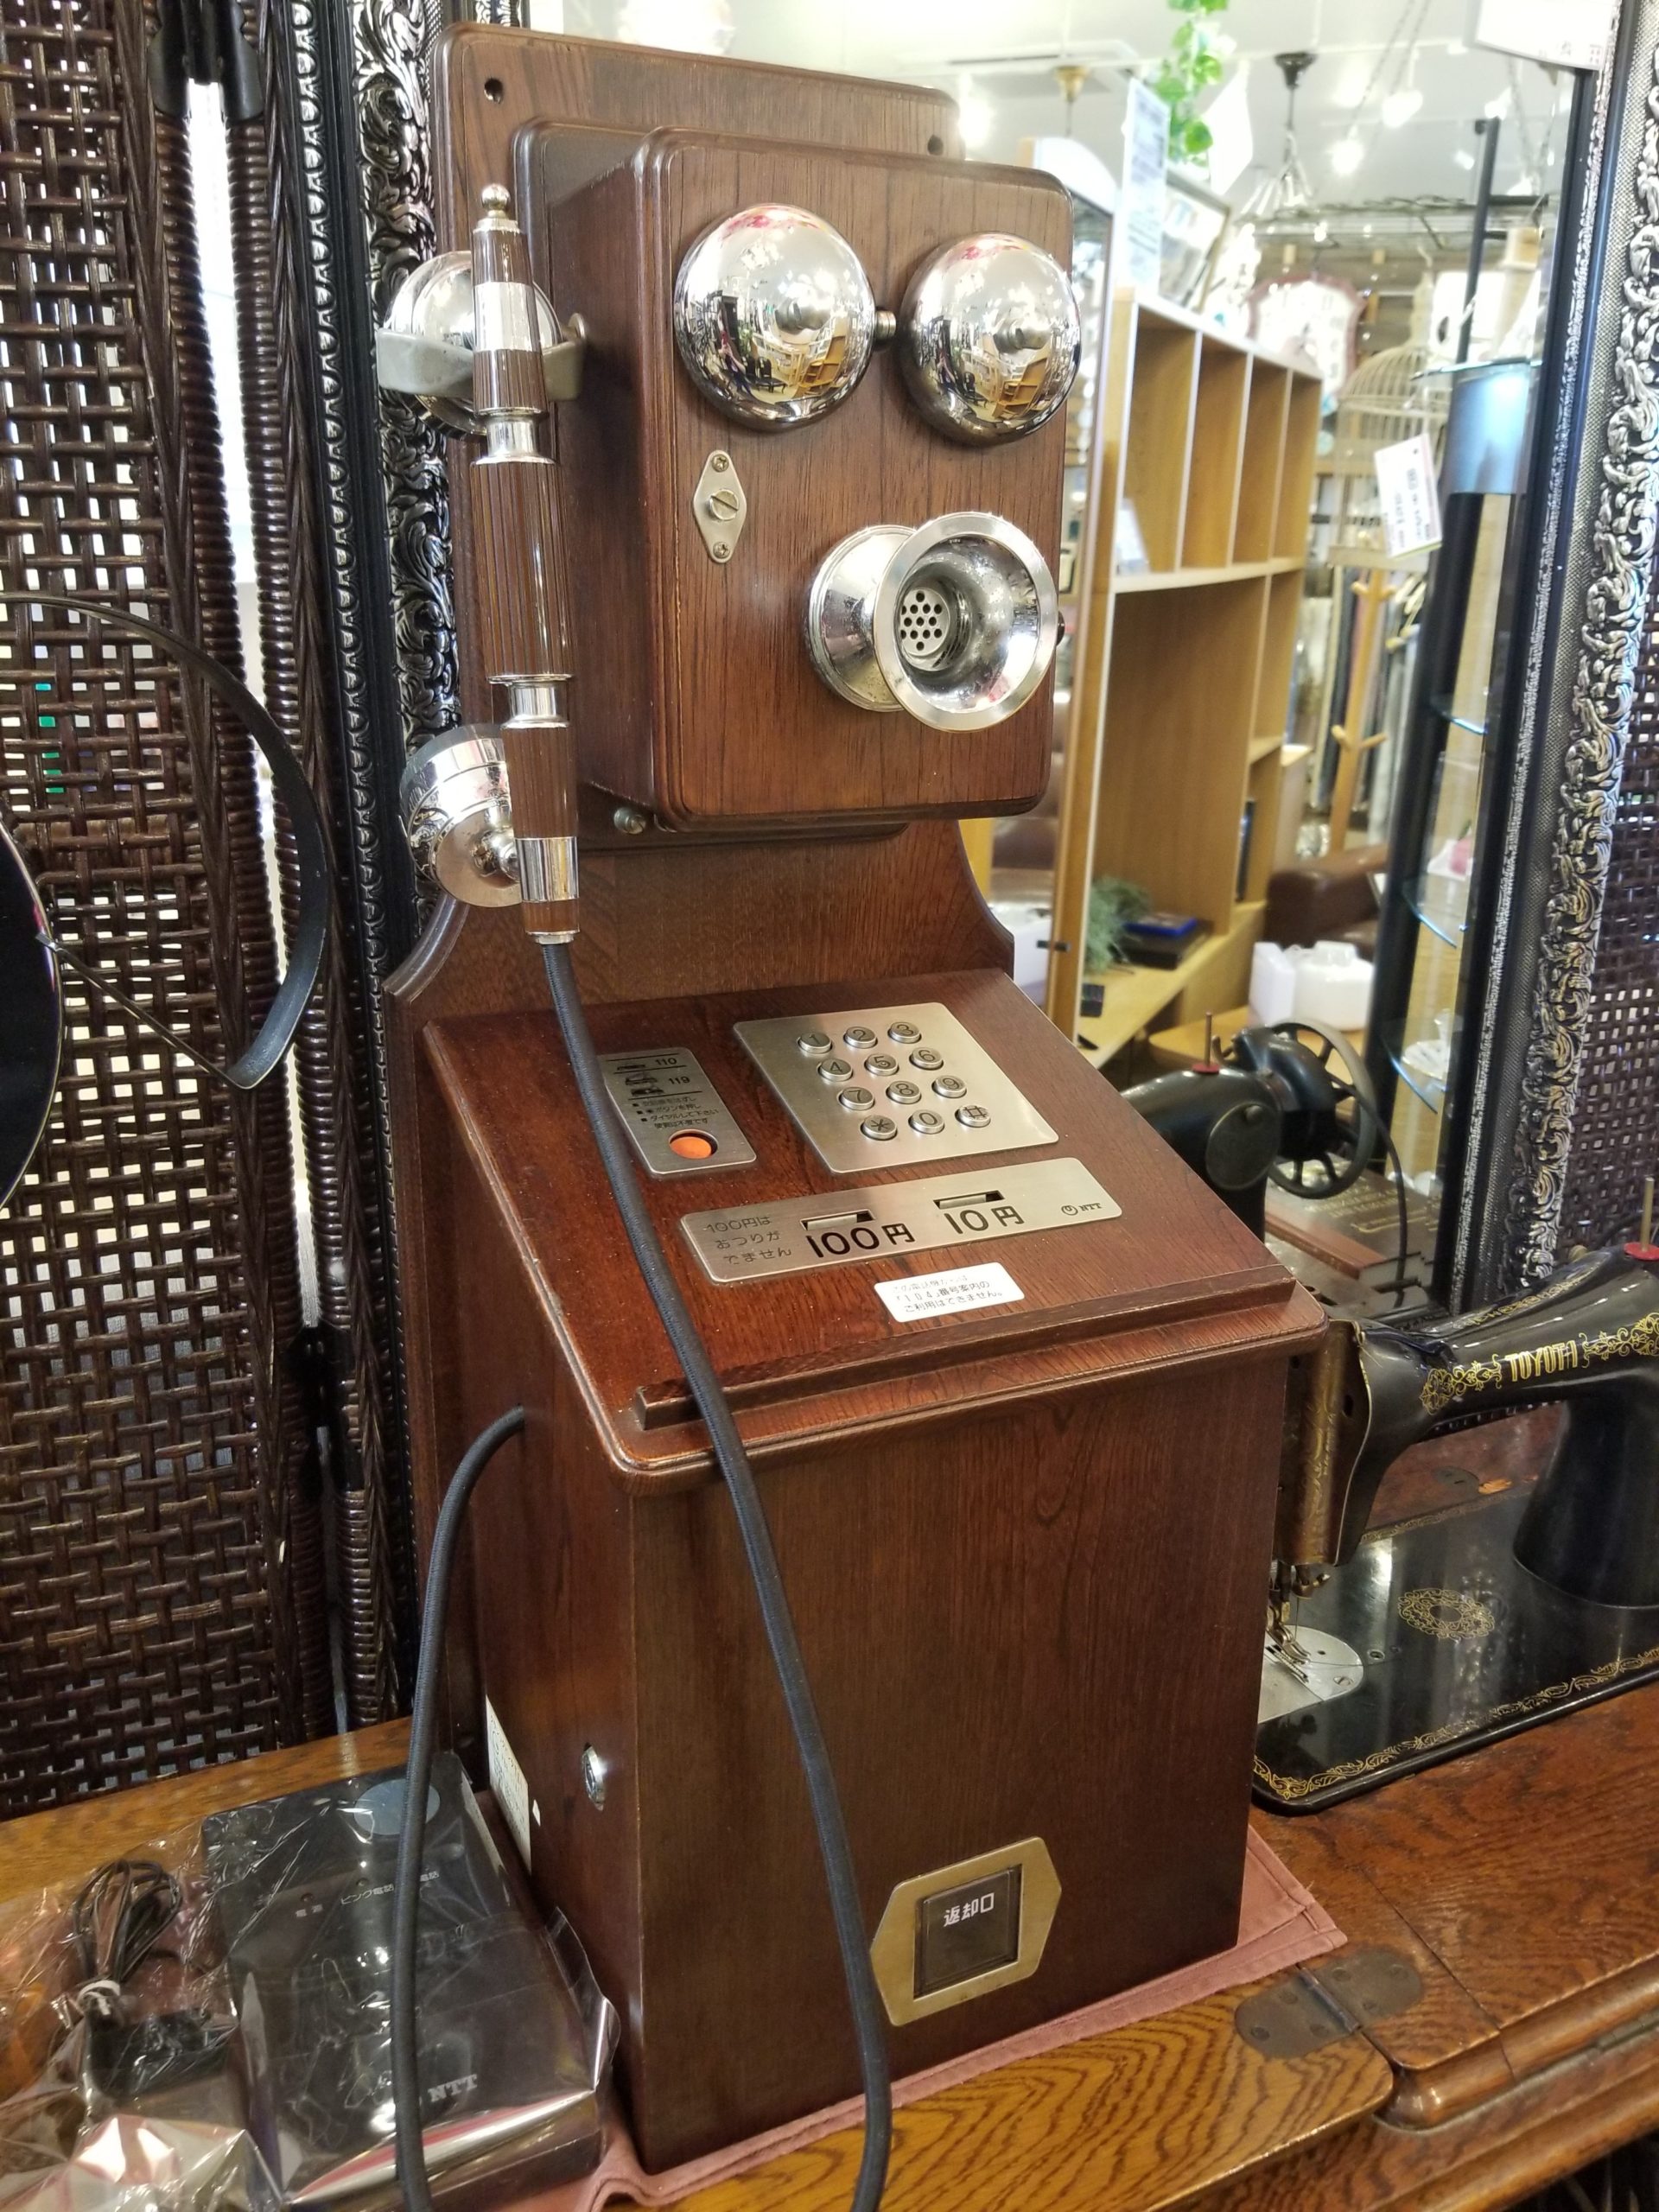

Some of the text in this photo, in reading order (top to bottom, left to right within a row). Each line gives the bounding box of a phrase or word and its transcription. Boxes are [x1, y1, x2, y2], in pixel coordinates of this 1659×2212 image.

[852, 1028, 867, 1041] 2
[896, 1024, 914, 1036] 3
[655, 1058, 677, 1066] 110
[830, 1049, 936, 1072] 4 5 6
[668, 1075, 690, 1085] 119
[848, 1077, 960, 1102] 7 8 9
[918, 1112, 938, 1125] 0
[1079, 1203, 1103, 1211] NTT
[705, 1216, 772, 1234] 100円は
[944, 1205, 1025, 1234] 10円
[715, 1230, 782, 1249] おつりが
[805, 1222, 916, 1258] 100円
[723, 1248, 792, 1265] でません
[1504, 1340, 1578, 1382] TOYOTA
[944, 1892, 995, 1928] 返却口
[428, 2074, 478, 2102] NTT
